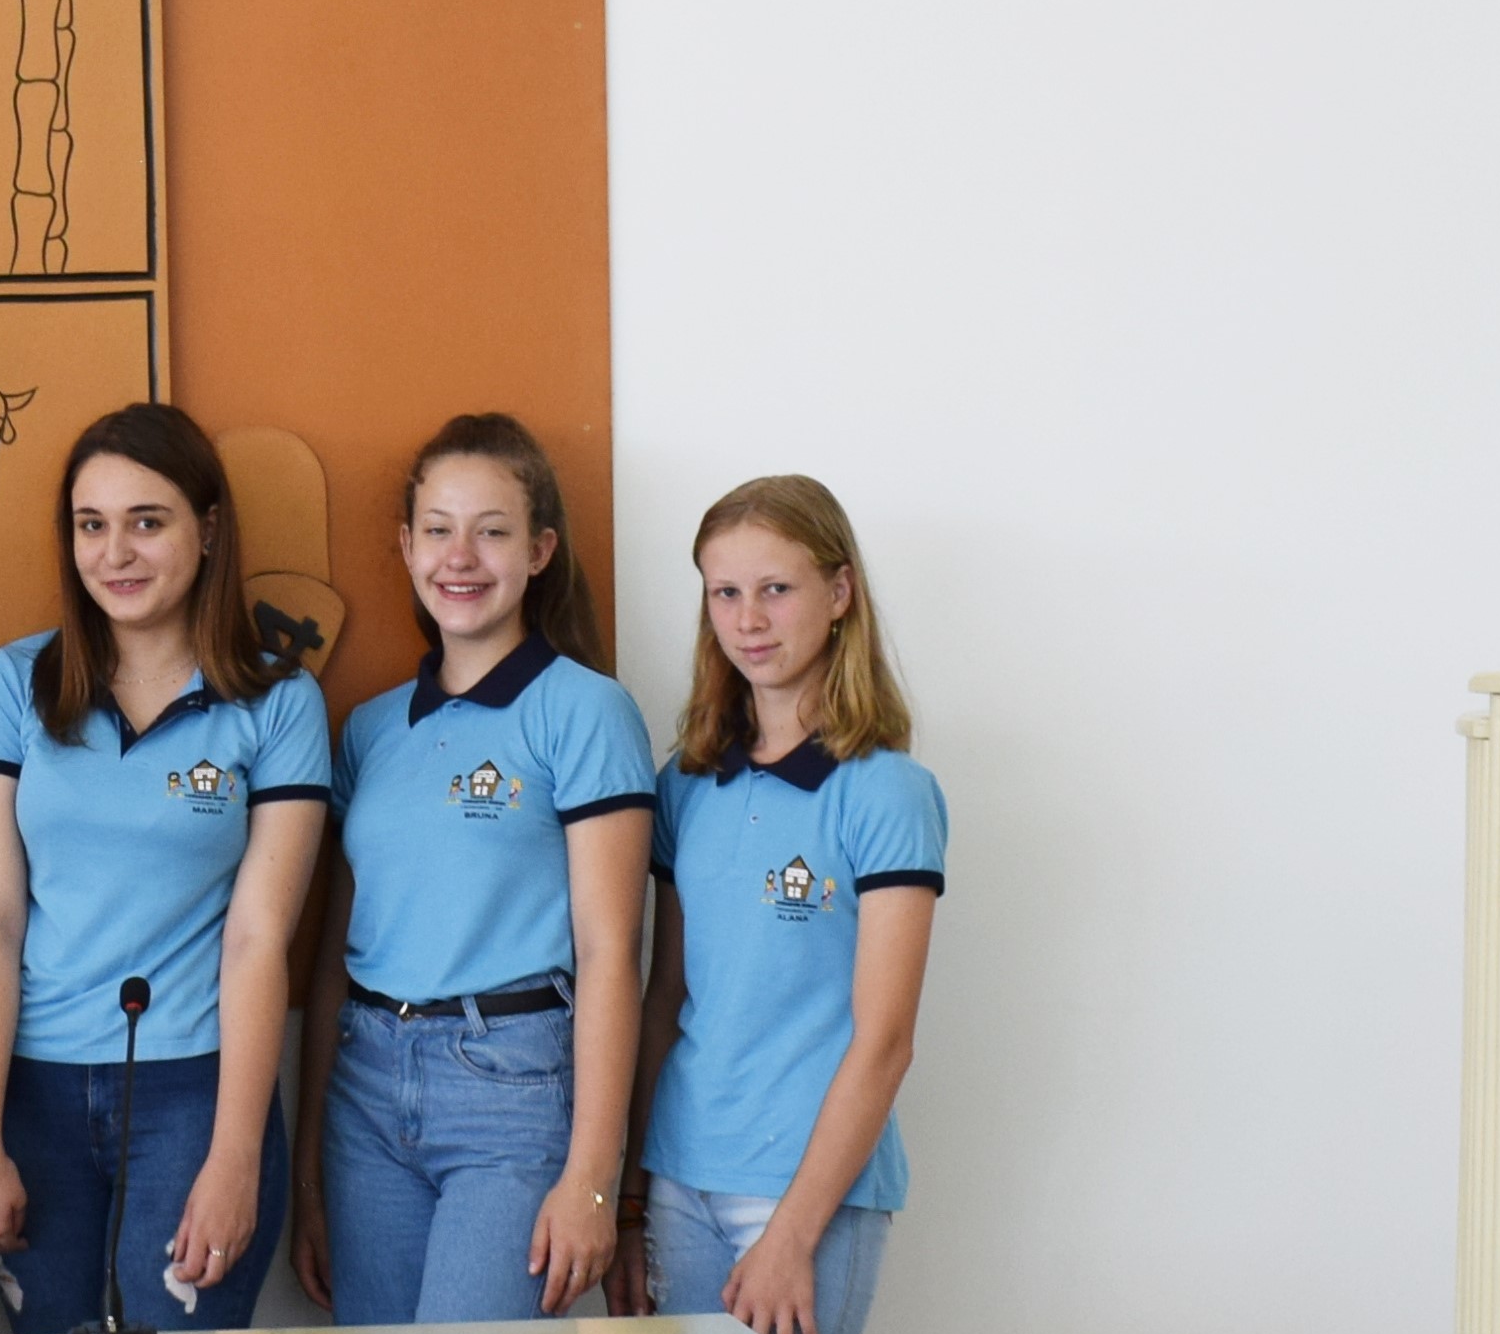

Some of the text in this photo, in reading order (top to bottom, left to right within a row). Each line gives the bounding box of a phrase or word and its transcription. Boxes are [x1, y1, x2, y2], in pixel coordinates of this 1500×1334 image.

[192, 806, 224, 816] MARIA
[464, 812, 500, 821] BRUNA
[777, 913, 809, 923] ALANA
